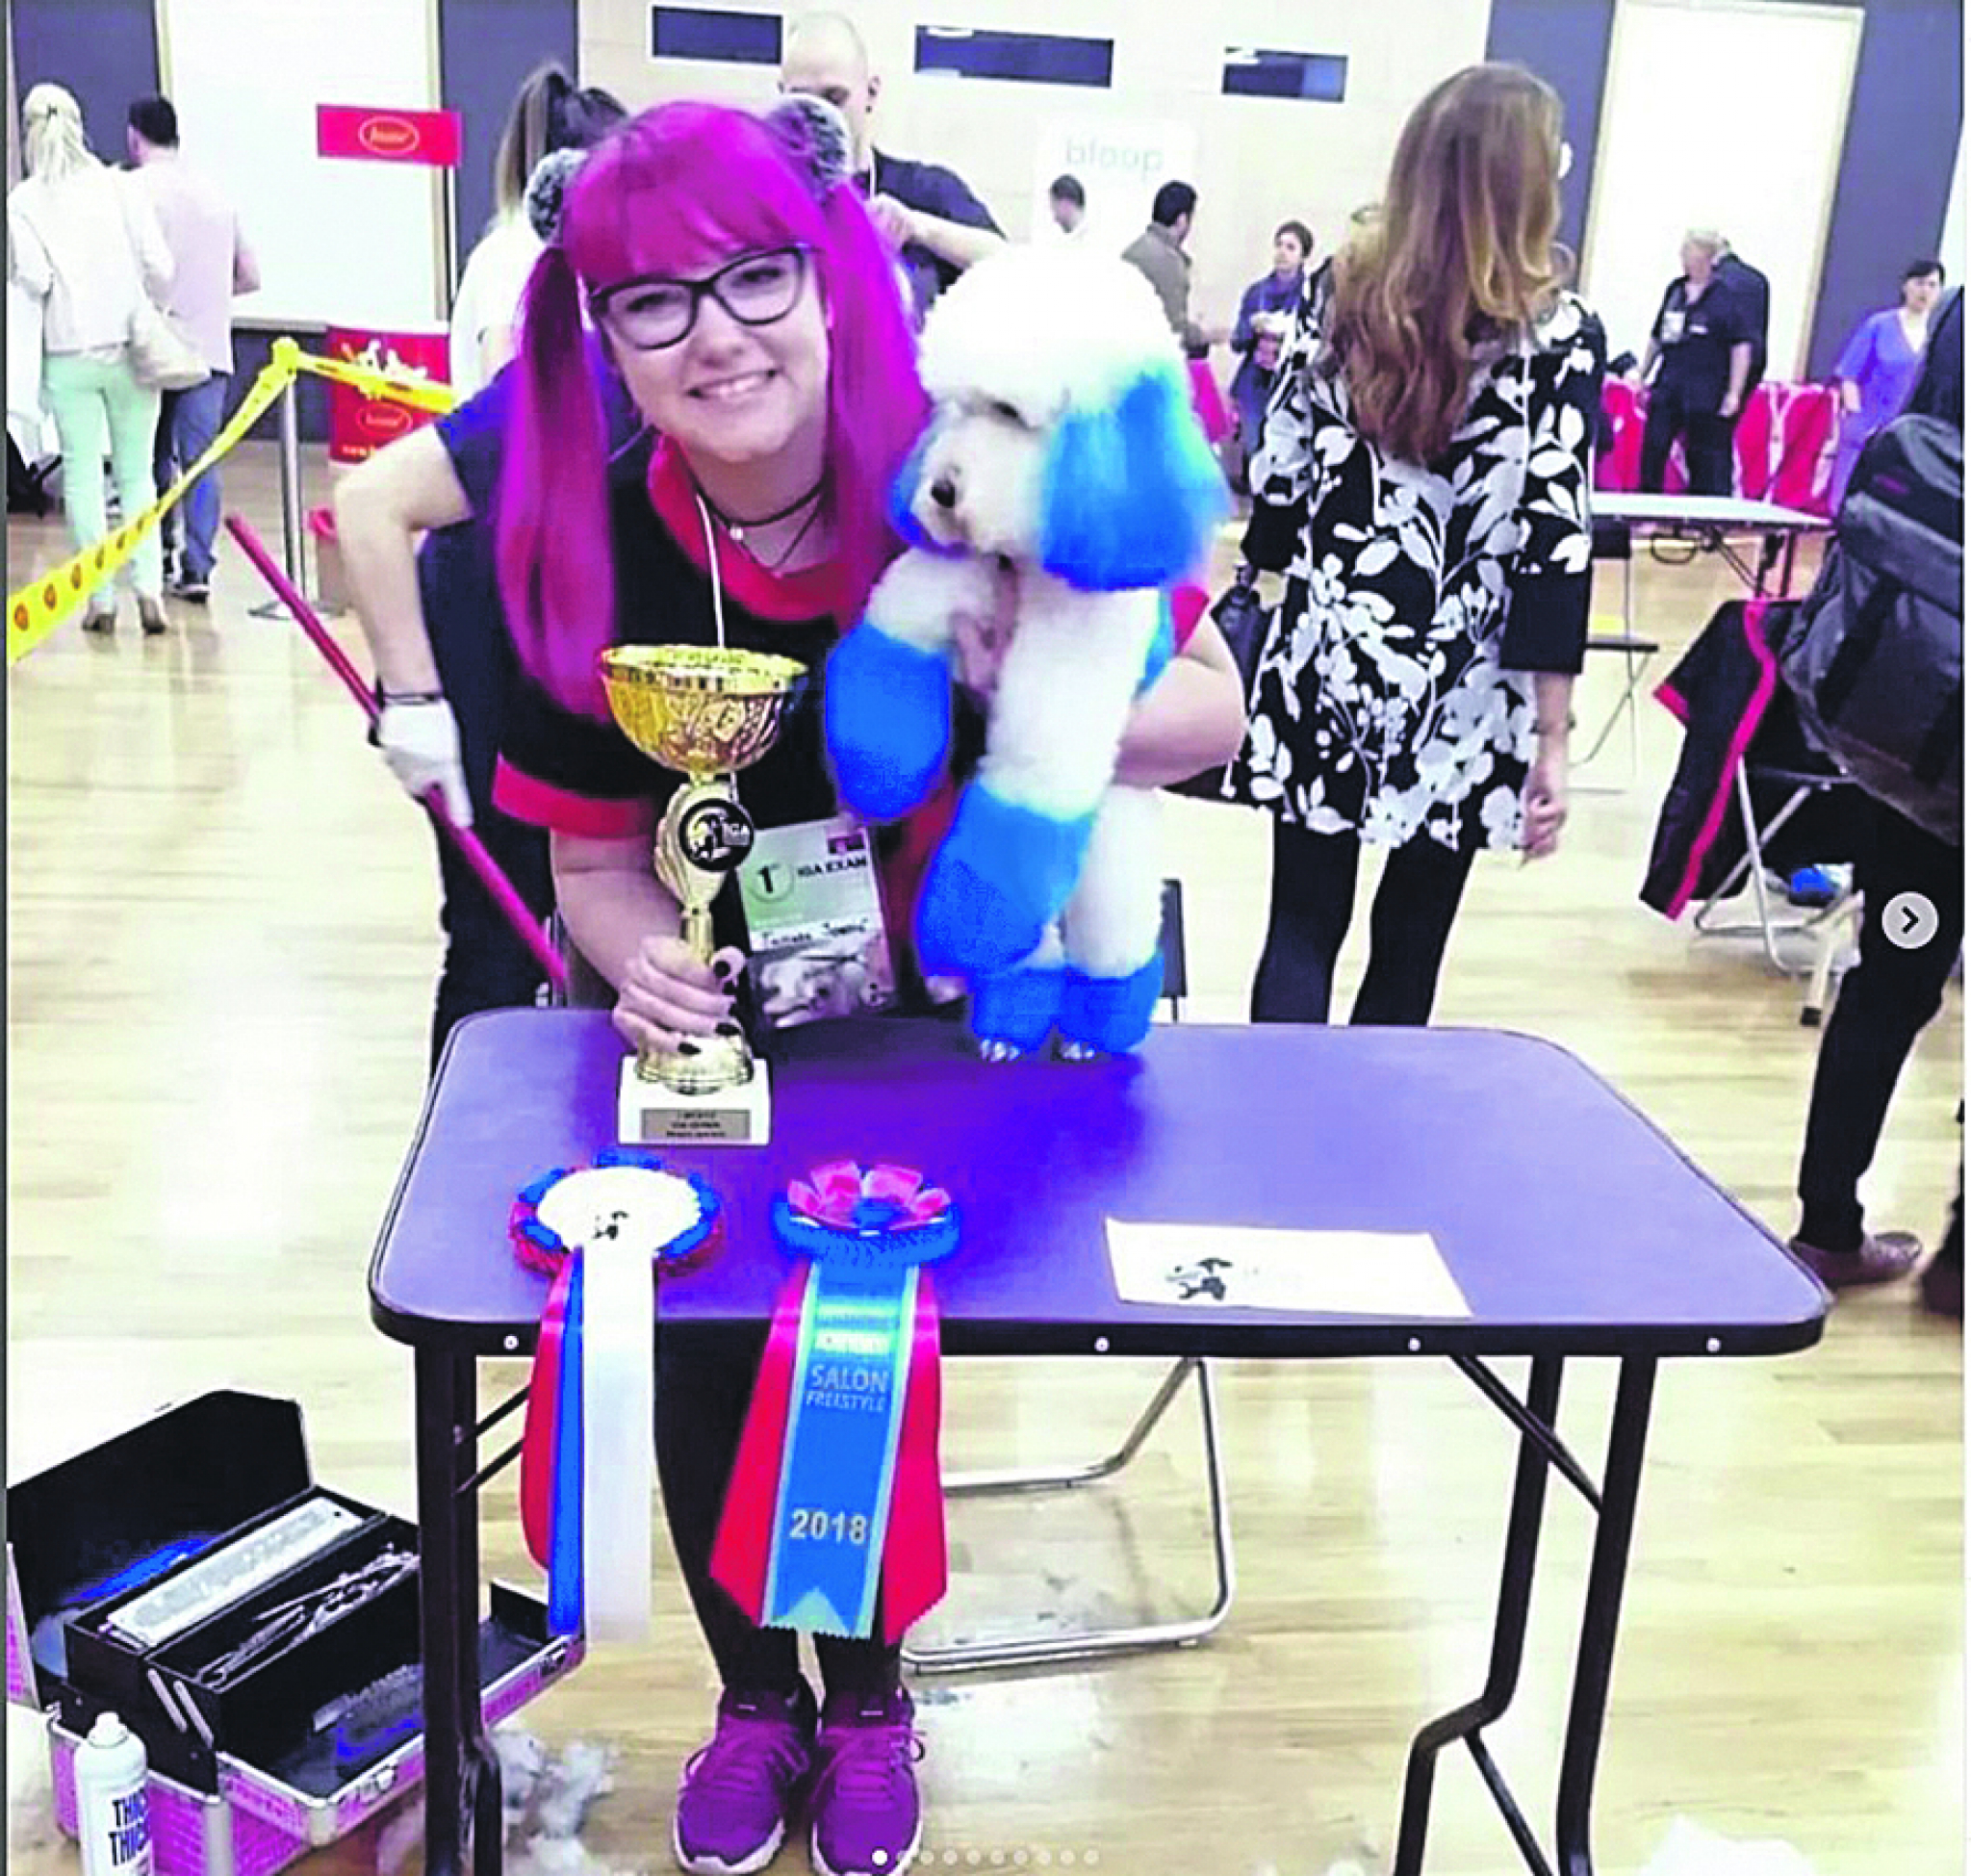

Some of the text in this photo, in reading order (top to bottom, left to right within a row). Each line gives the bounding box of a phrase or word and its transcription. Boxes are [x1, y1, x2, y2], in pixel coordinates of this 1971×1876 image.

[826, 856, 868, 874] EXAM
[811, 1363, 888, 1393] SALON
[789, 1507, 867, 1546] 2018
